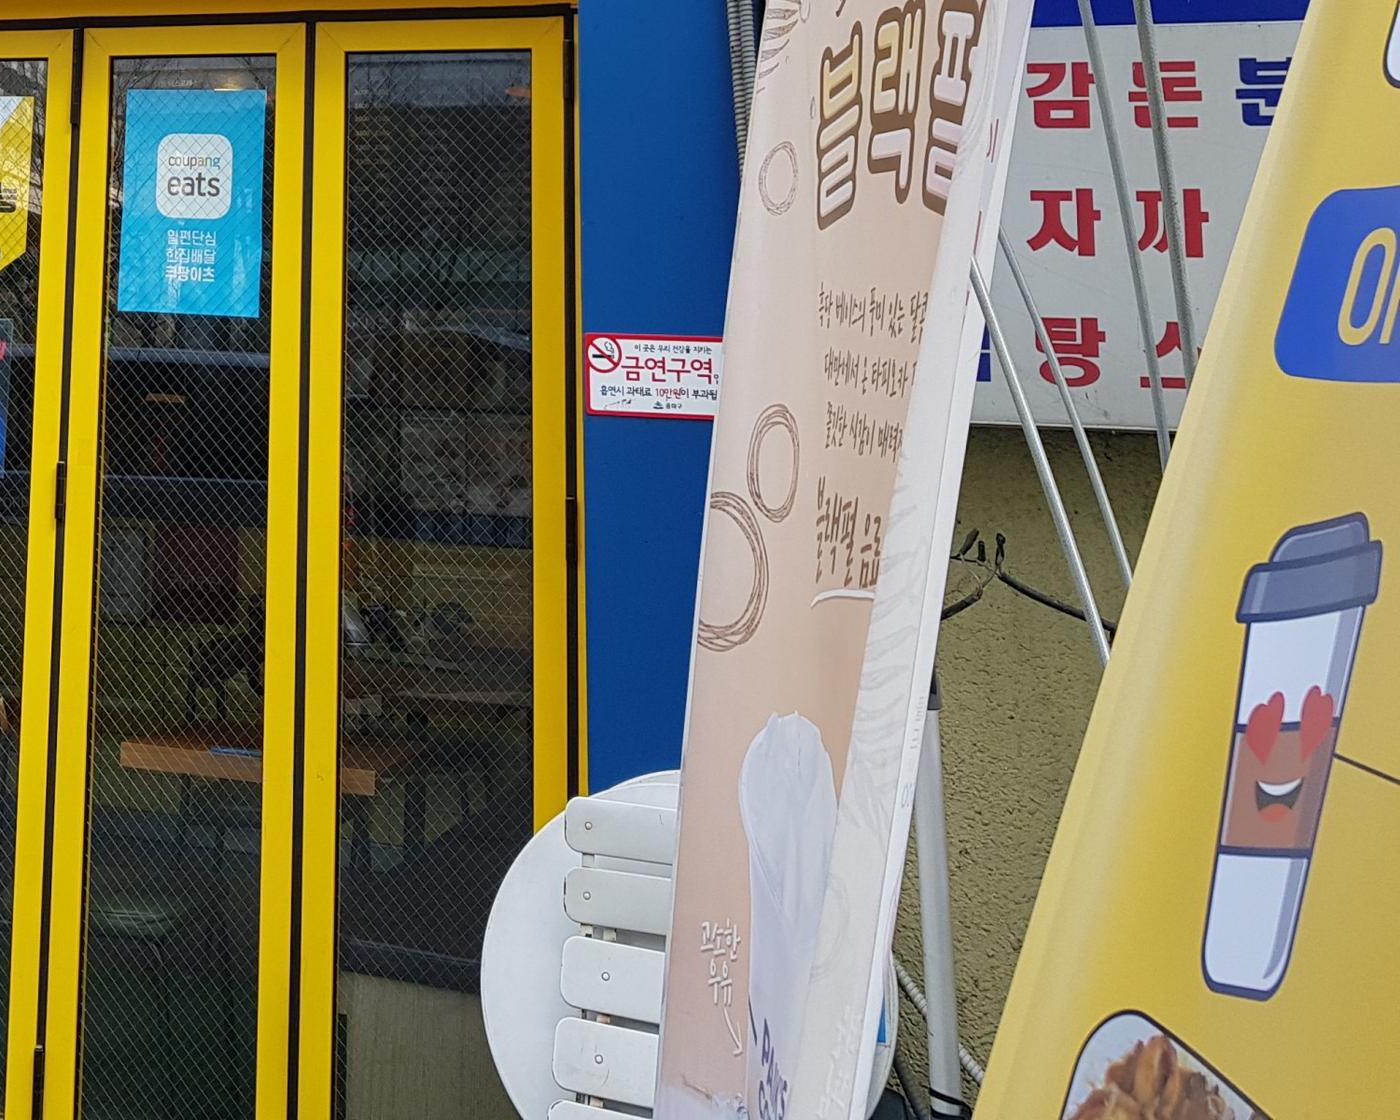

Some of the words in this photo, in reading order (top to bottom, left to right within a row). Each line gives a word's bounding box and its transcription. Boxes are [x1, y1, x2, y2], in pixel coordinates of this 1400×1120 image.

[168, 154, 221, 170] coupang
[167, 172, 220, 197] eats
[165, 266, 215, 282] 쿠팡이츠
[835, 291, 866, 333] 베이스의
[888, 292, 905, 338] 있는
[621, 356, 712, 384] 금연구역
[870, 357, 908, 399] 타피오카
[627, 386, 652, 397] 과태료
[655, 387, 689, 401] 10만원이
[816, 475, 860, 588] 블랙펄
[700, 917, 741, 961] 고소한
[708, 961, 734, 1008] 우유
